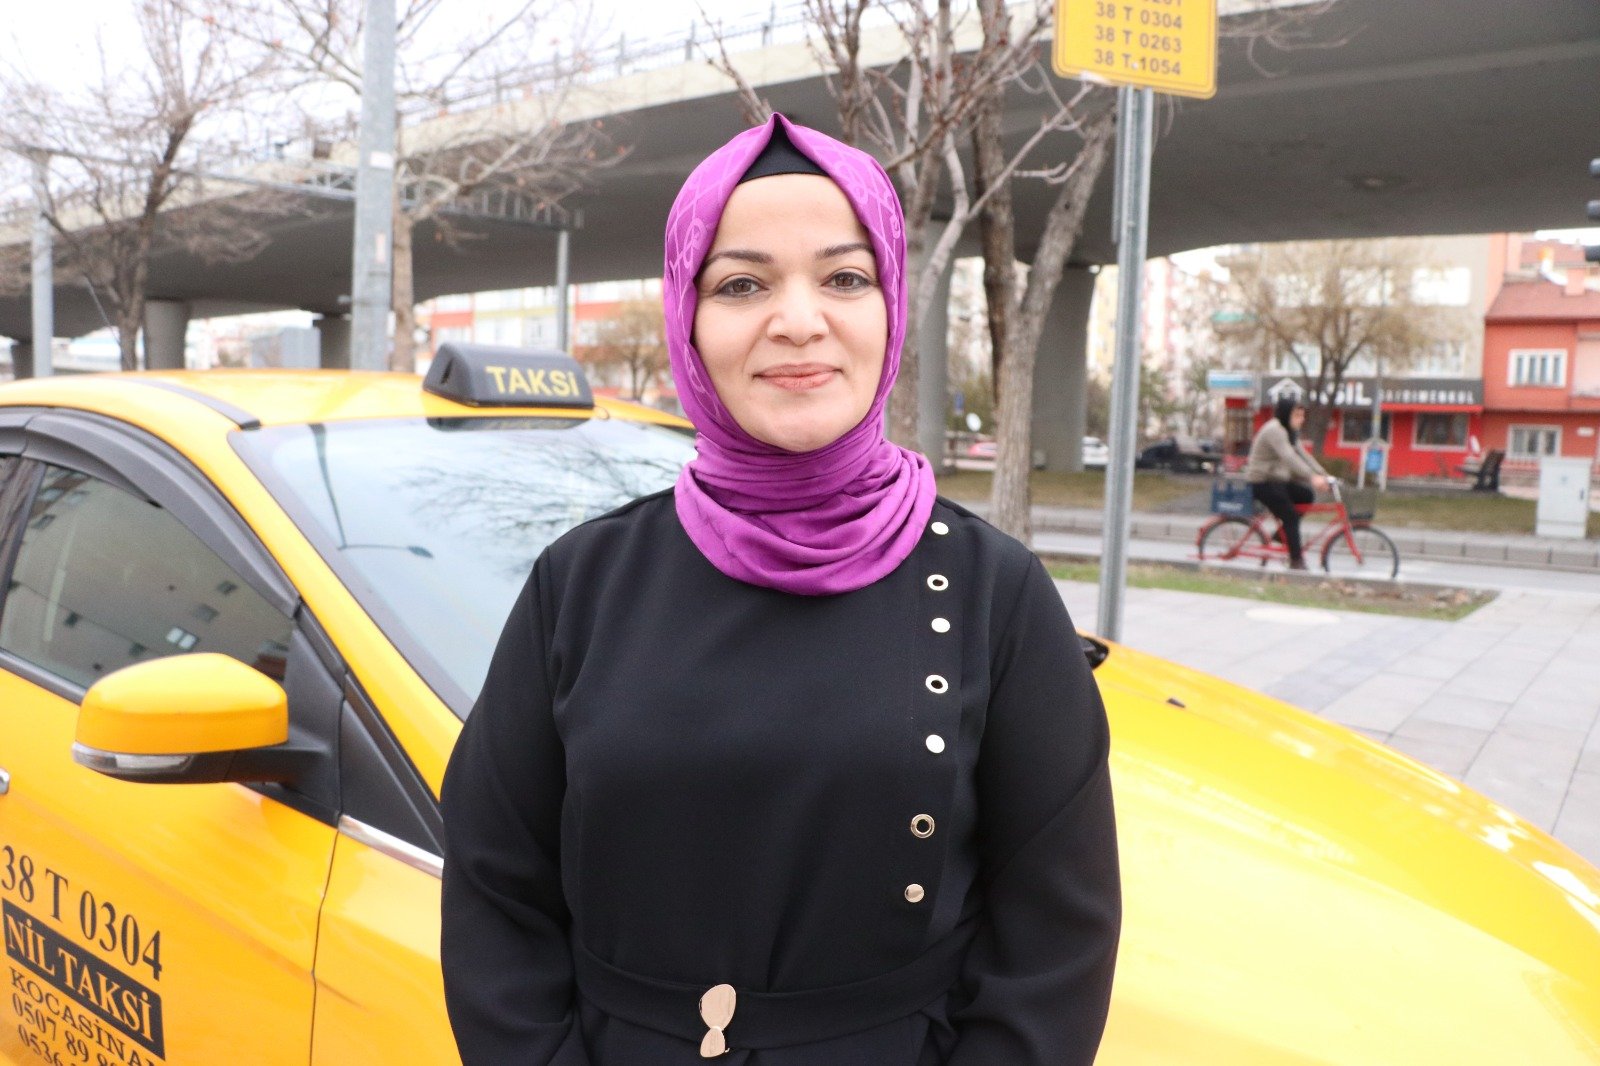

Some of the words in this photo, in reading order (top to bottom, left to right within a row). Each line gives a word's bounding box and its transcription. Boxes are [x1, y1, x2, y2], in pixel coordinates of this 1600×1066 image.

[1095, 25, 1115, 42] 38
[1122, 30, 1132, 45] T
[1139, 33, 1182, 53] 0263
[1096, 1, 1116, 19] 38
[1123, 6, 1133, 21] T
[1140, 9, 1182, 29] 0304
[1094, 49, 1114, 66] 38
[1122, 53, 1131, 69] T
[1139, 57, 1181, 75] 1054
[1, 845, 35, 903] 38
[45, 867, 69, 923] T
[79, 890, 163, 982] 0304
[6, 913, 56, 977] NİL
[57, 948, 155, 1043] TAKSİ
[12, 993, 57, 1041] 0507
[65, 1030, 89, 1062] 89
